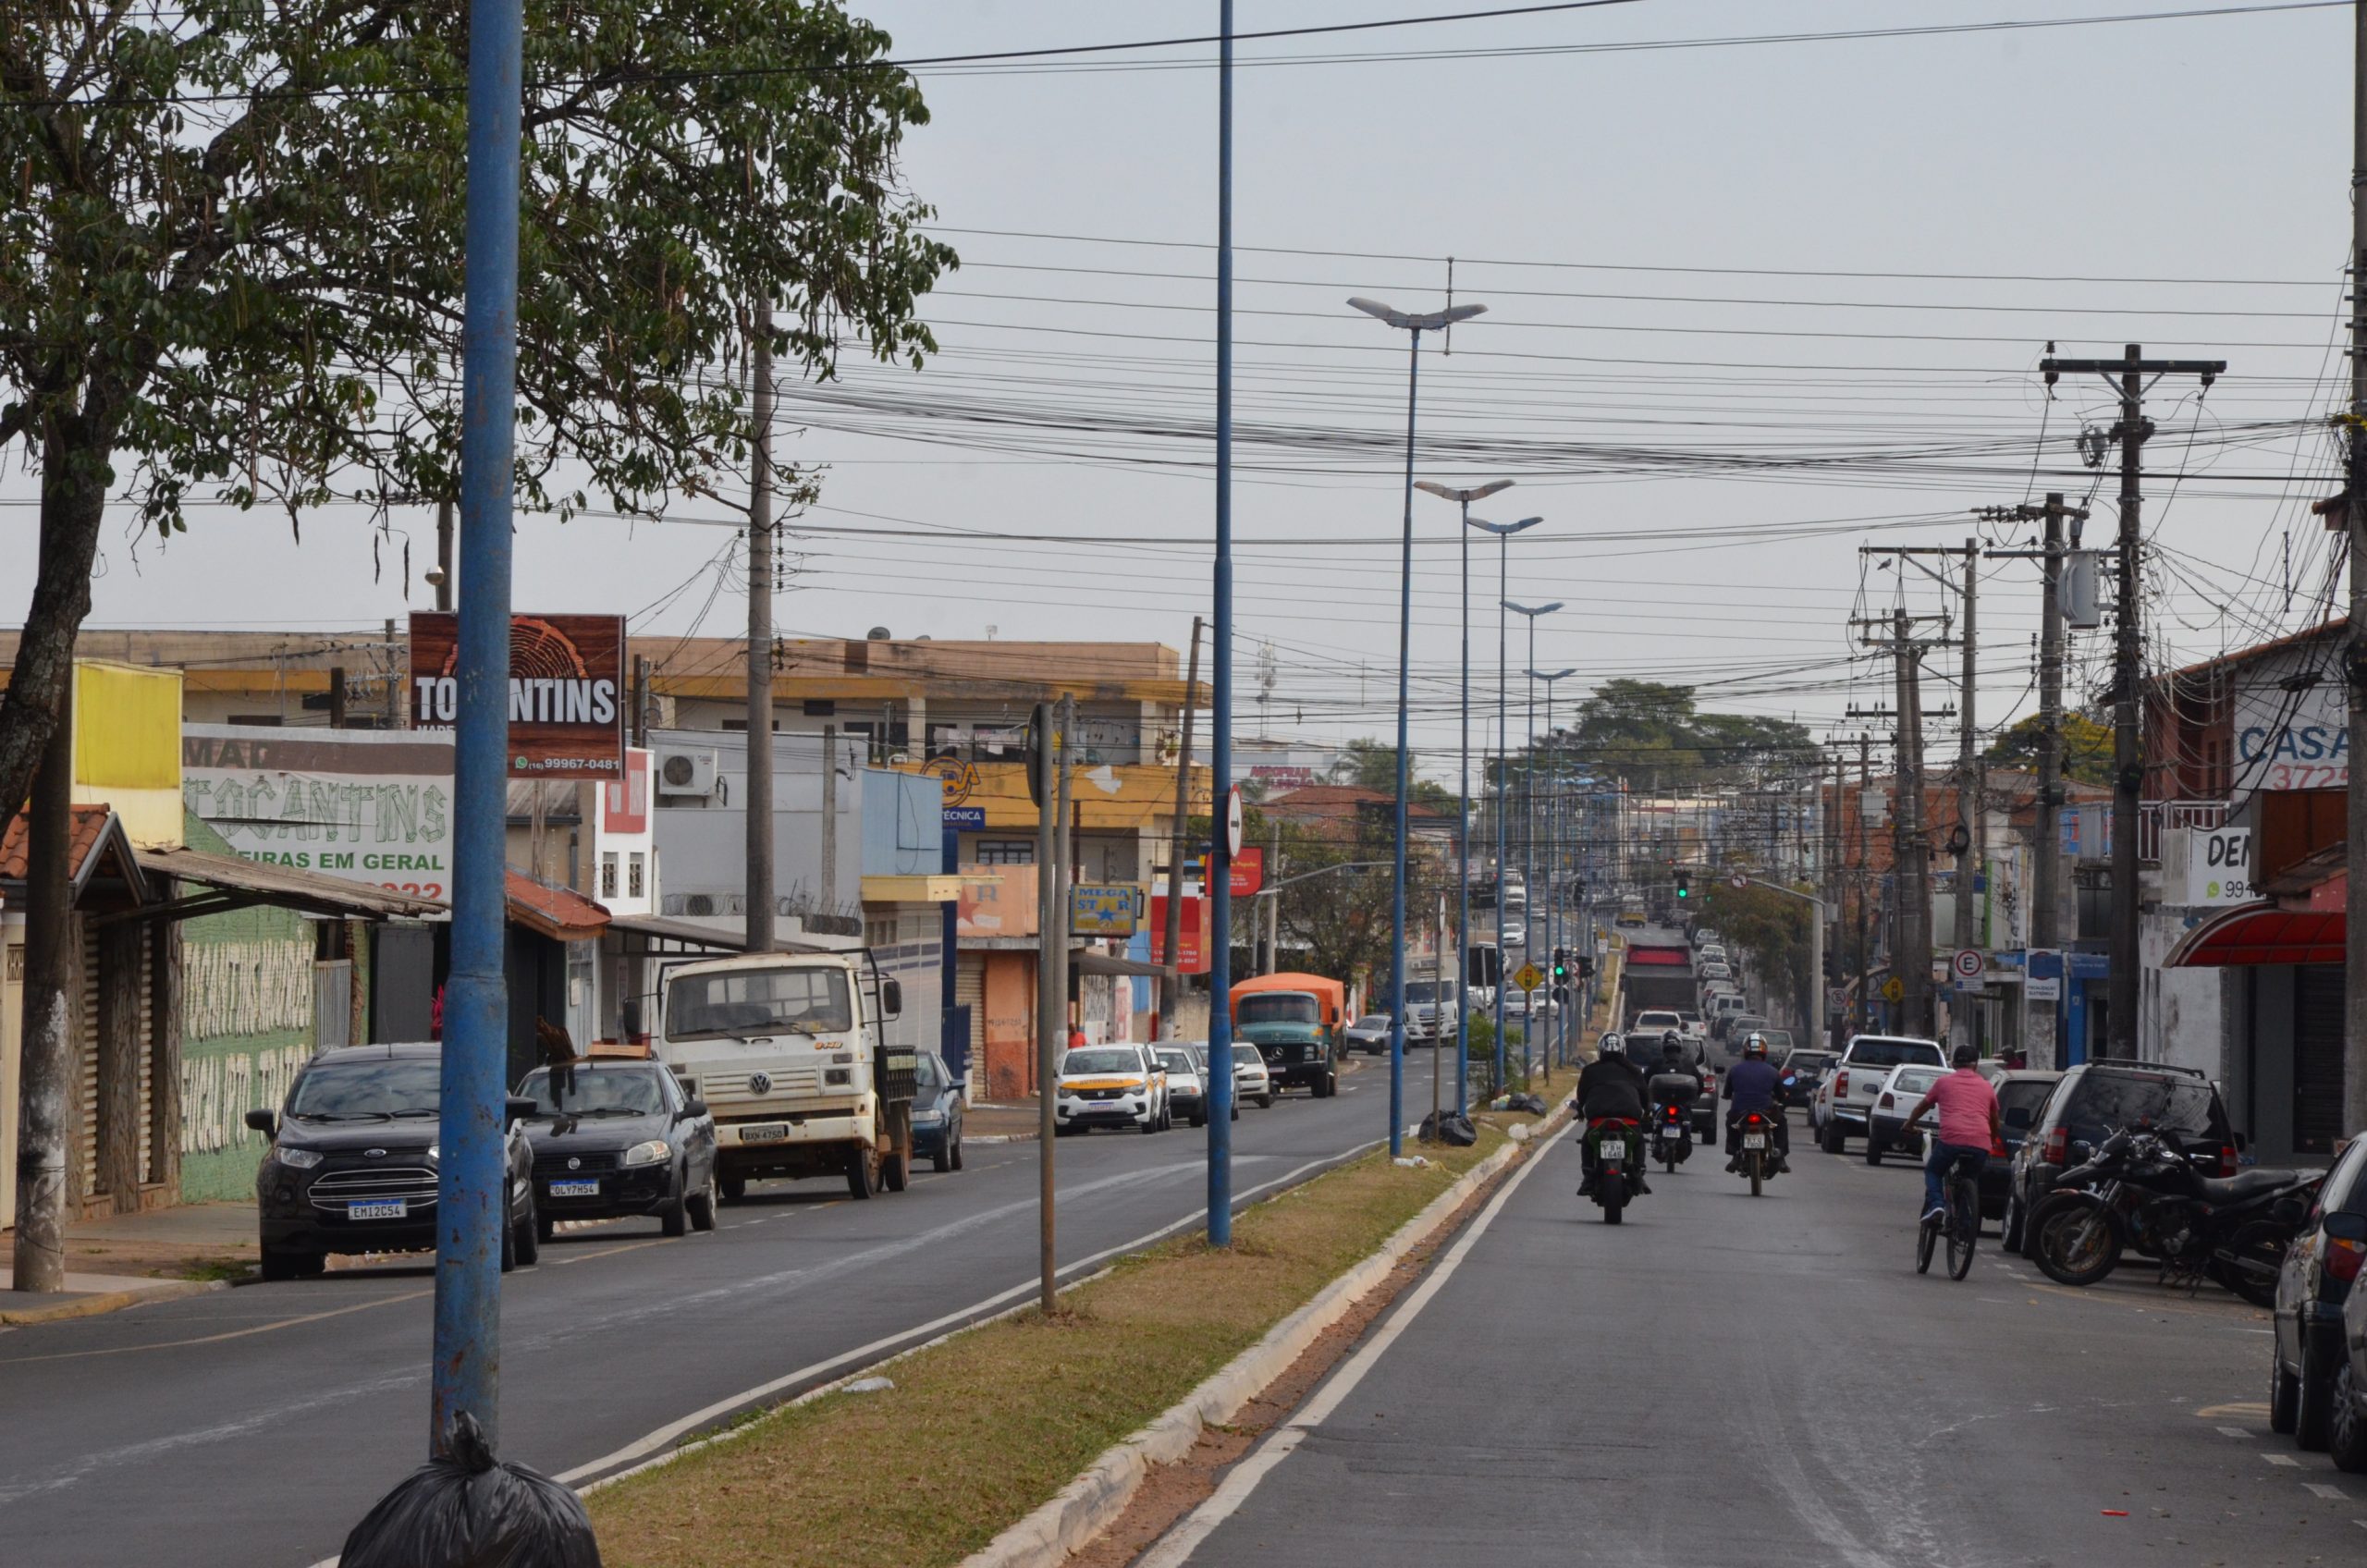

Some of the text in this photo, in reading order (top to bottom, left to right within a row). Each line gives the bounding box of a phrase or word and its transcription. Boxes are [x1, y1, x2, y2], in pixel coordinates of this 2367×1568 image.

[416, 677, 616, 724] TONTINS
[545, 758, 620, 770] 99967-0481
[319, 852, 355, 869] EM
[362, 854, 445, 871] GERAL
[1079, 888, 1128, 897] MEGA
[1963, 957, 1974, 970] E
